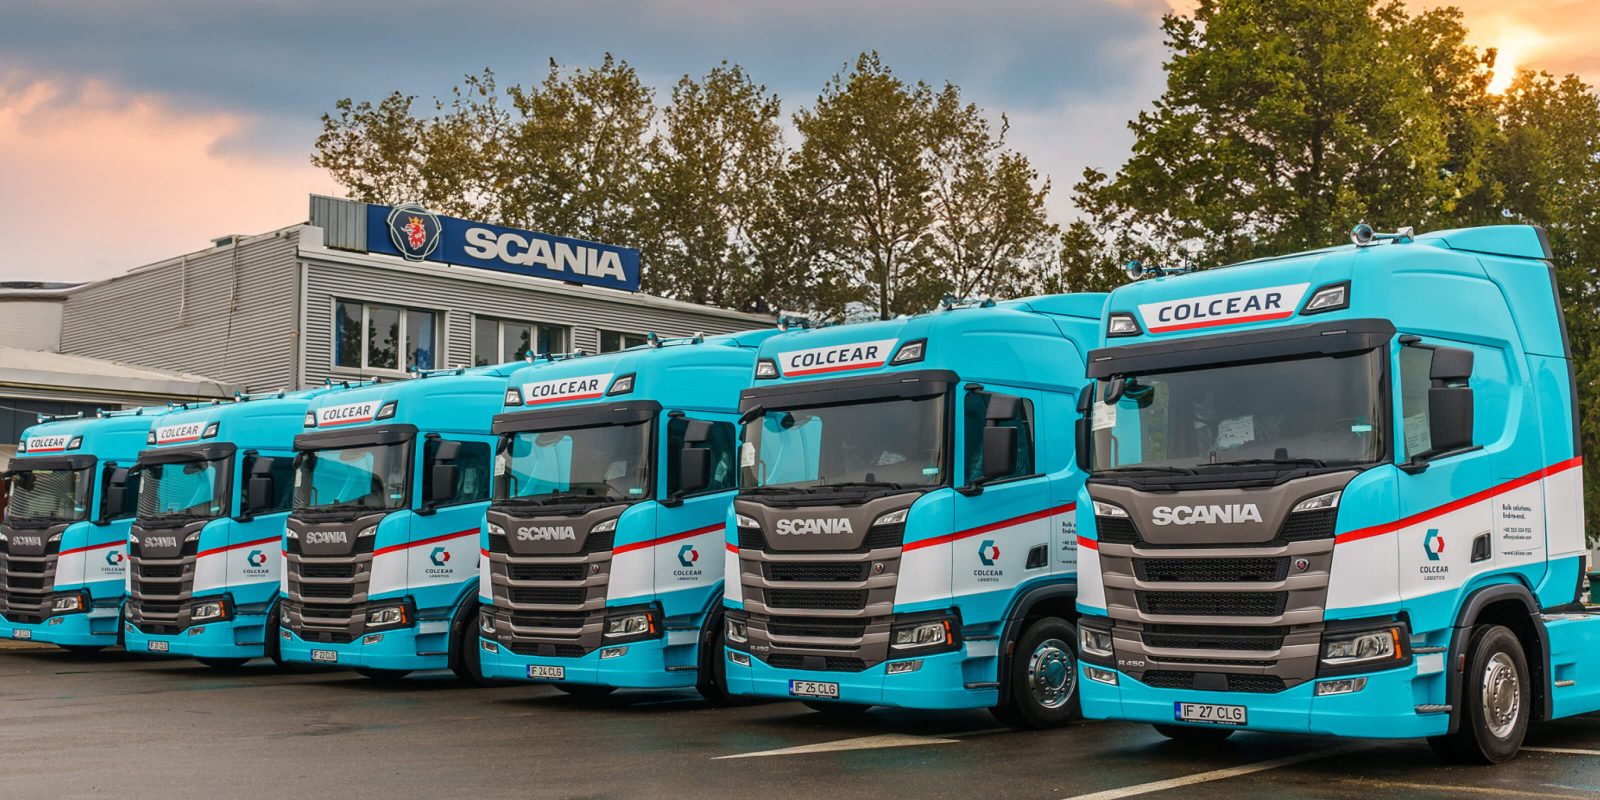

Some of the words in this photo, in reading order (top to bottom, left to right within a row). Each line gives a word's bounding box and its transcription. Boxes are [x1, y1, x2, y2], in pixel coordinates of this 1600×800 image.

[464, 227, 626, 281] SCANIA
[1158, 292, 1282, 323] COLCEAR
[790, 346, 878, 368] COLCEAR
[532, 379, 599, 397] COLCEAR
[323, 405, 371, 420] COLCEAR
[161, 425, 199, 439] COLCEAR
[30, 438, 65, 448] COLCEAR
[1152, 503, 1263, 526] SCANIA
[517, 526, 576, 541] SCANIA
[776, 517, 853, 535] SCANIA
[12, 536, 41, 547] SCANIA
[144, 536, 177, 547] SCANIA
[306, 531, 347, 544] SCANIA
[1419, 565, 1449, 573] COLCEAR
[548, 667, 562, 676] CLG
[795, 682, 803, 692] IF
[806, 682, 816, 693] 25
[818, 683, 836, 695] CLG
[1183, 704, 1195, 717] IF
[1199, 705, 1213, 718] 27
[1216, 706, 1242, 720] CLG
